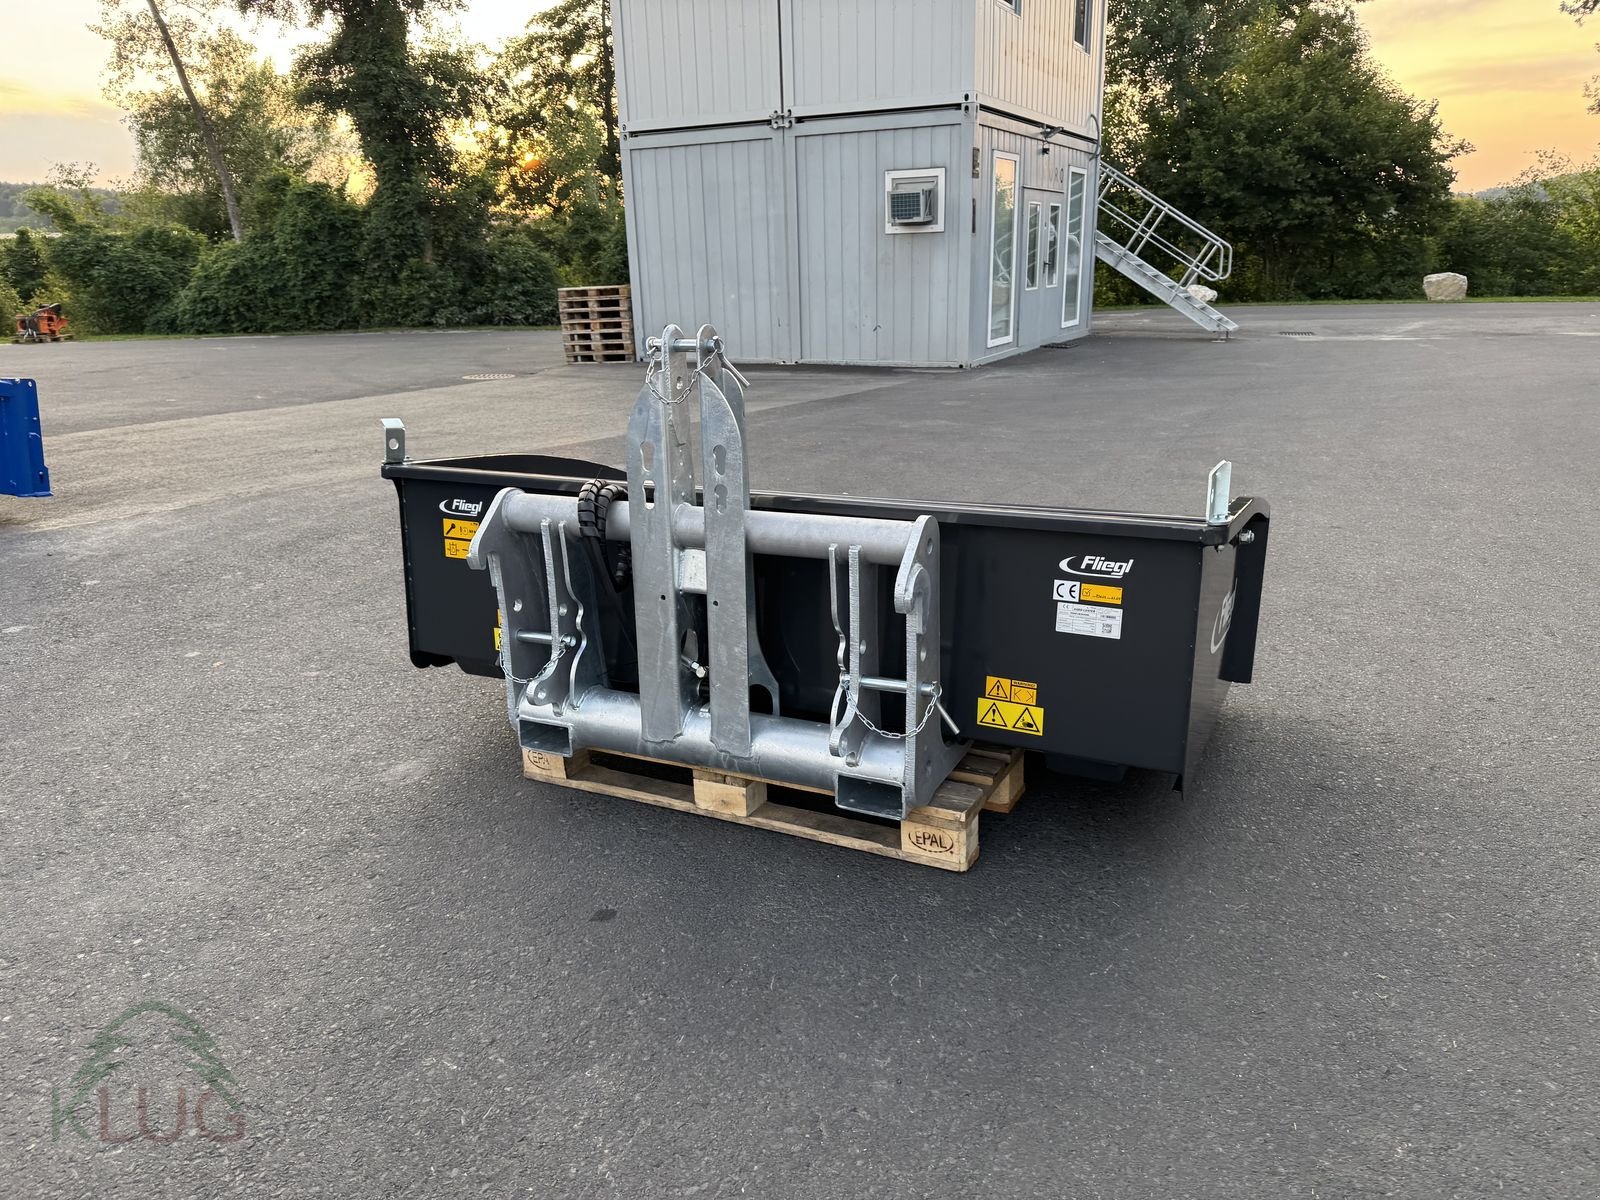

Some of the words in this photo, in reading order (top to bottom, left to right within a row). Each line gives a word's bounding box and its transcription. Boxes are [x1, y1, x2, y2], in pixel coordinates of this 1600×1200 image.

[452, 499, 482, 514] Fliegl
[1080, 555, 1134, 576] Fliegl
[1056, 583, 1077, 599] CE
[915, 831, 947, 849] EPAL
